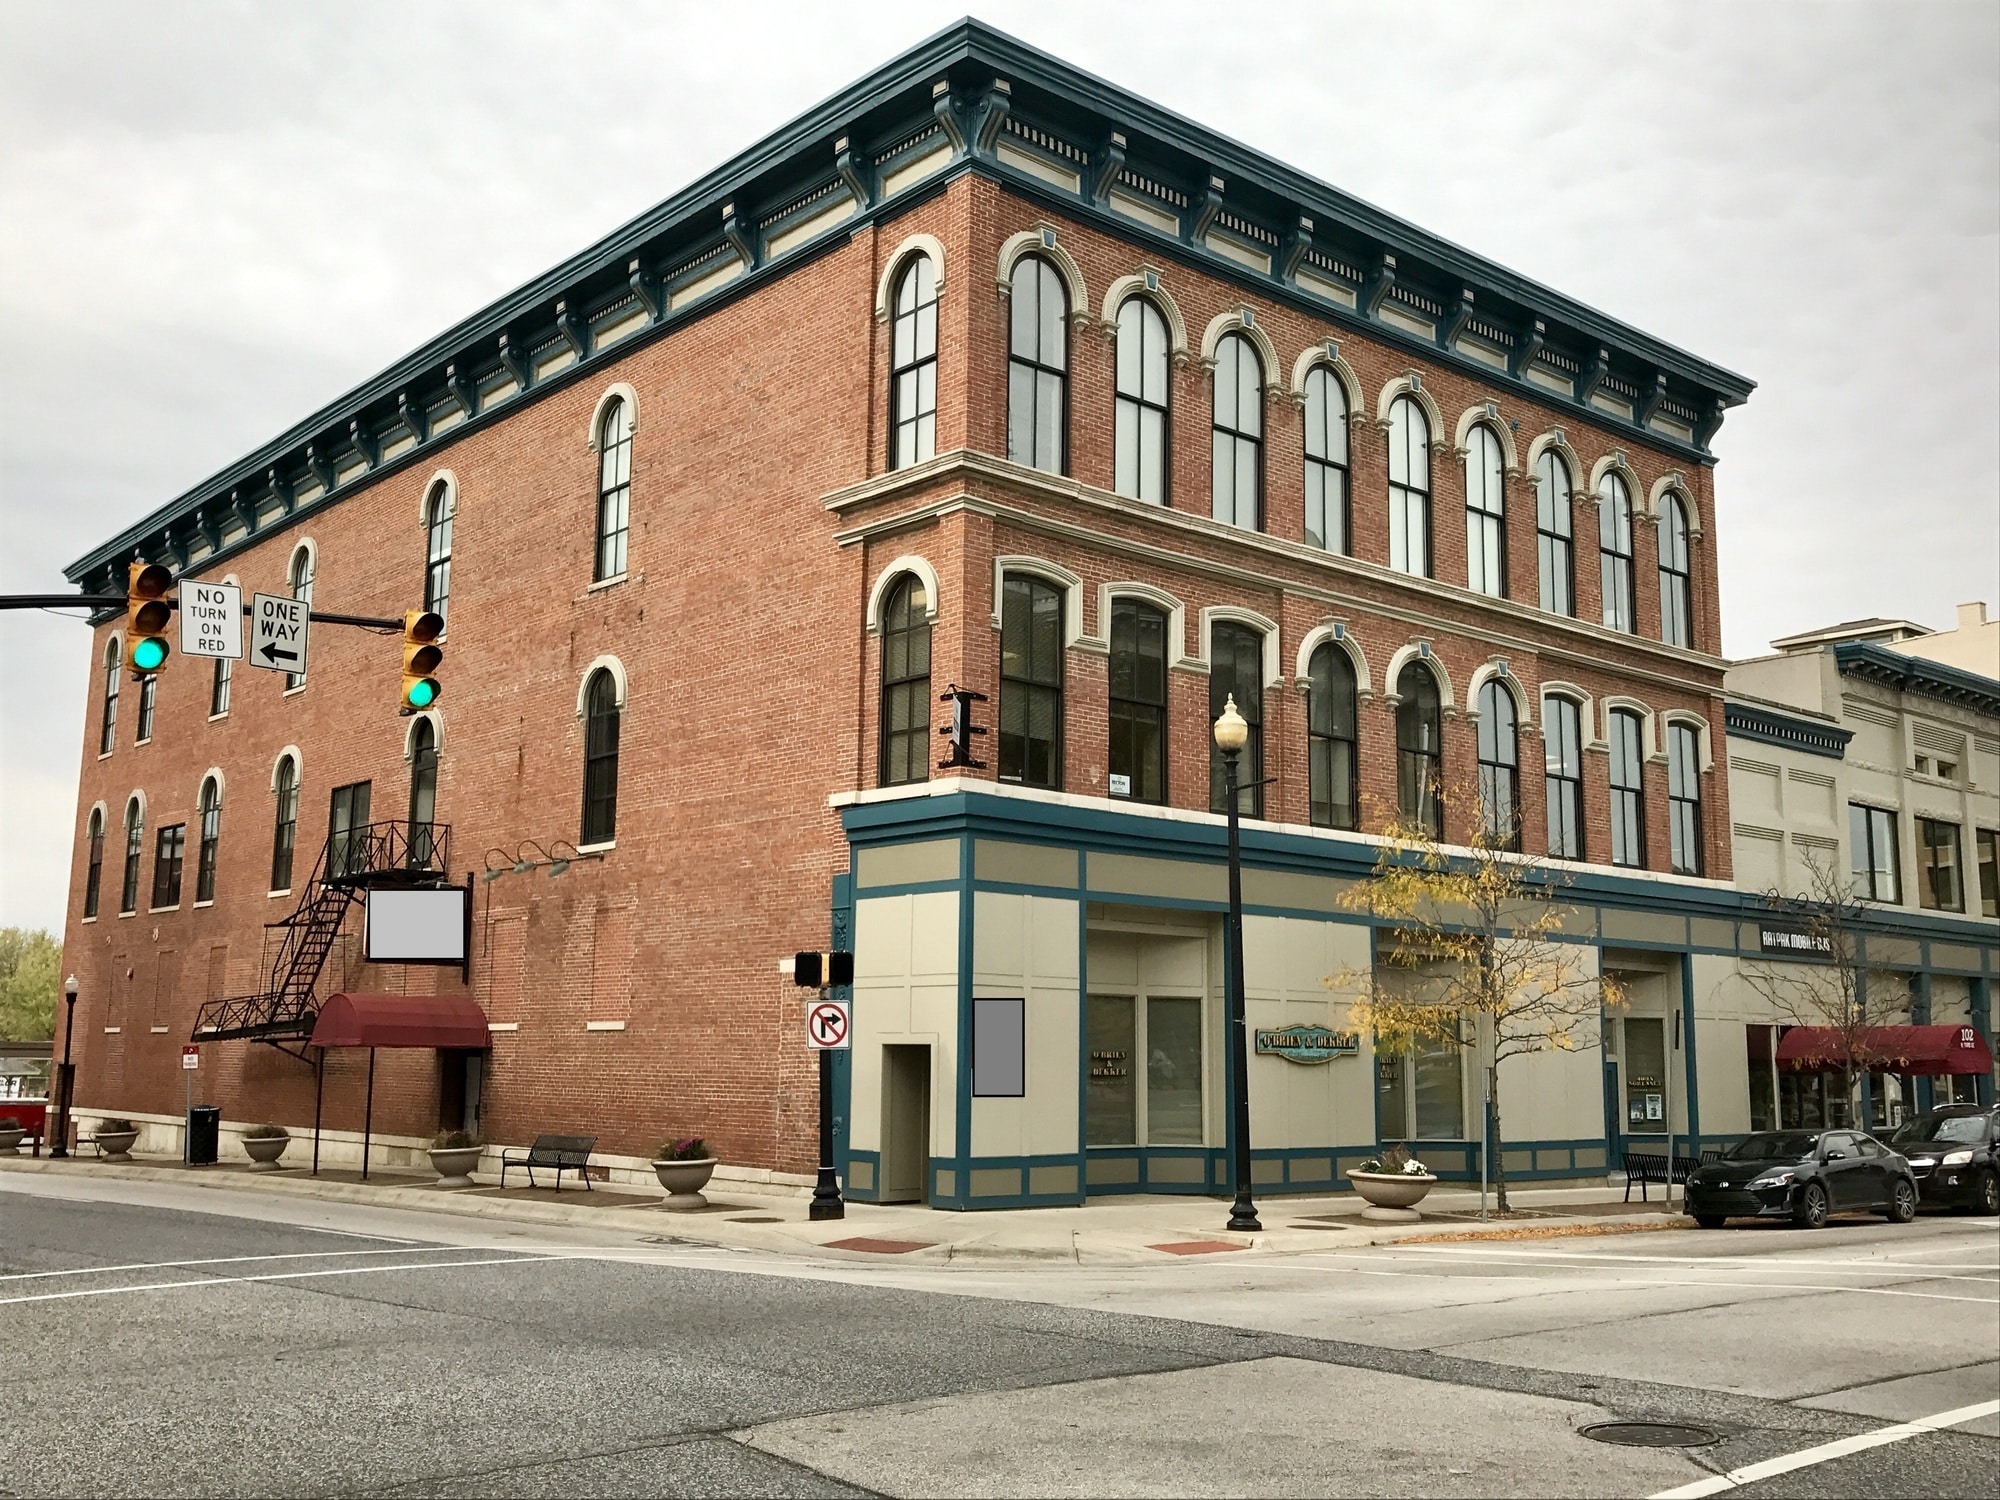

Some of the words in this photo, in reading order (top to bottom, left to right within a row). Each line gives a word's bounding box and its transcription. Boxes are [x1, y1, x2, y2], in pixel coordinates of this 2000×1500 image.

[197, 588, 225, 605] NO
[190, 605, 226, 620] TURN
[263, 601, 299, 622] ONE
[201, 623, 221, 635] ON
[261, 619, 300, 641] WAY
[198, 638, 225, 651] RED
[1790, 934, 1816, 950] MOBILE
[1263, 1034, 1302, 1047] O'BRIEN
[1305, 1035, 1313, 1047] &
[1961, 1028, 1974, 1041] 102
